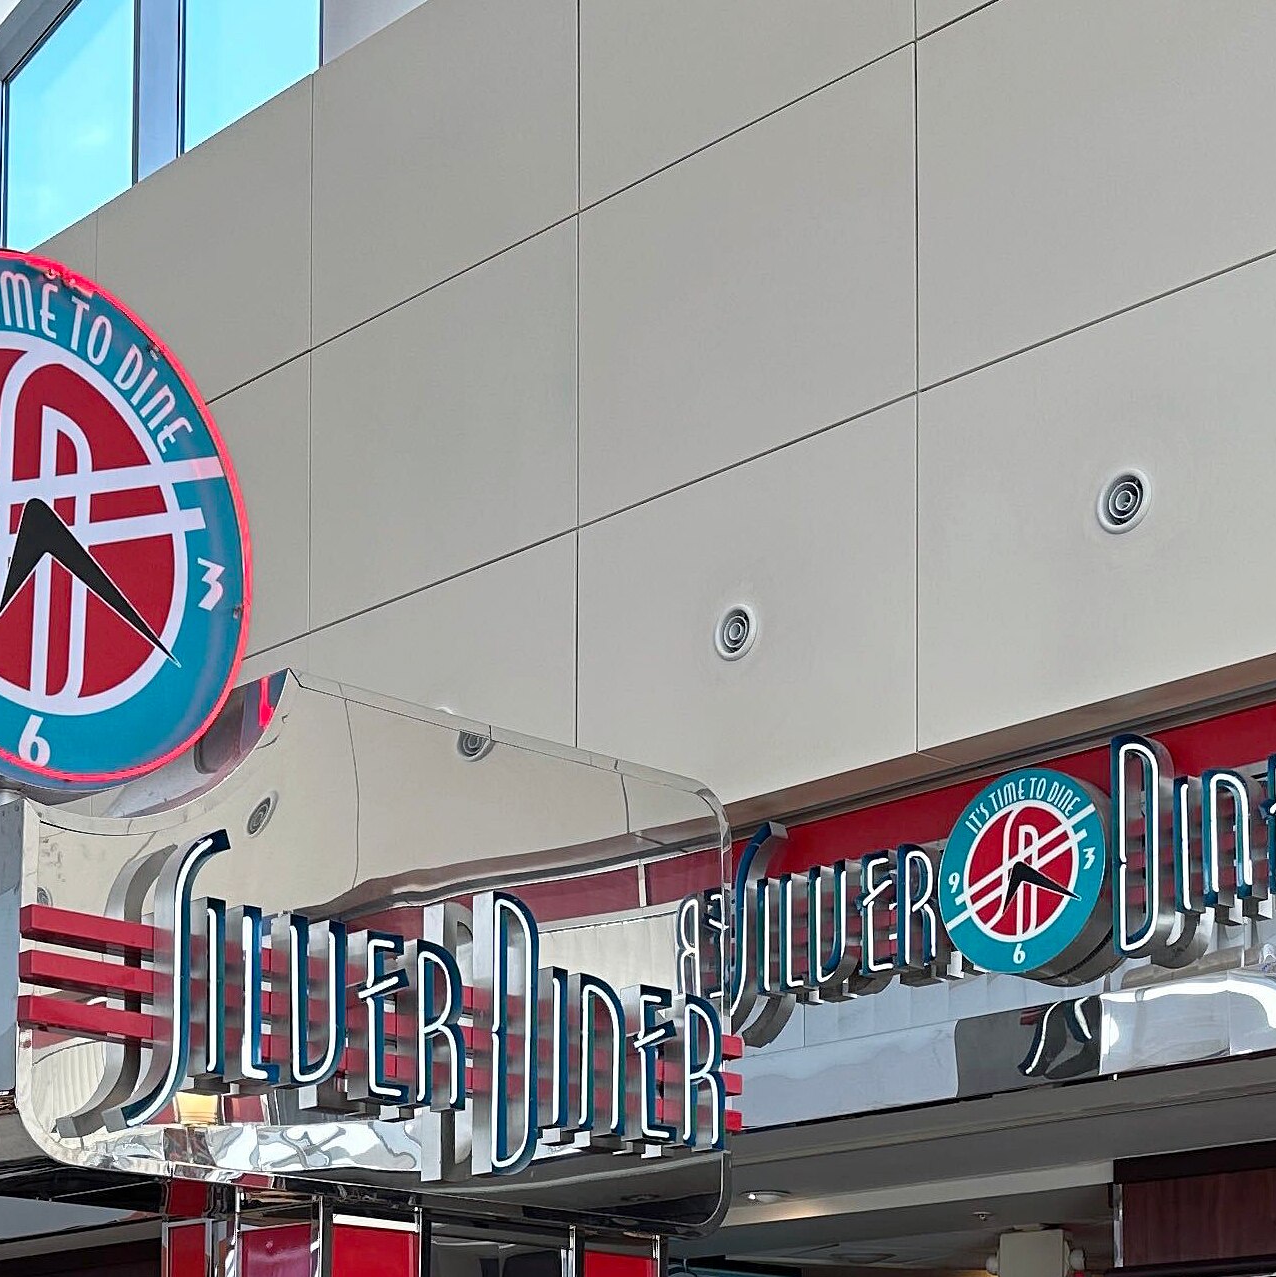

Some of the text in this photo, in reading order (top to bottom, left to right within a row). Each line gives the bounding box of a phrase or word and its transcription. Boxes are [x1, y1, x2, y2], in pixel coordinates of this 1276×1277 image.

[58, 295, 113, 366] TO
[112, 343, 194, 455] DINE
[196, 556, 227, 612] 3
[18, 715, 51, 768] 6
[964, 777, 1082, 835] IT'S TIME TO DINE
[948, 872, 960, 894] 9
[1083, 846, 1096, 870] 3
[730, 821, 937, 1017] SILVER
[1012, 942, 1026, 965] 6
[121, 828, 725, 1178] SILVER DINER
